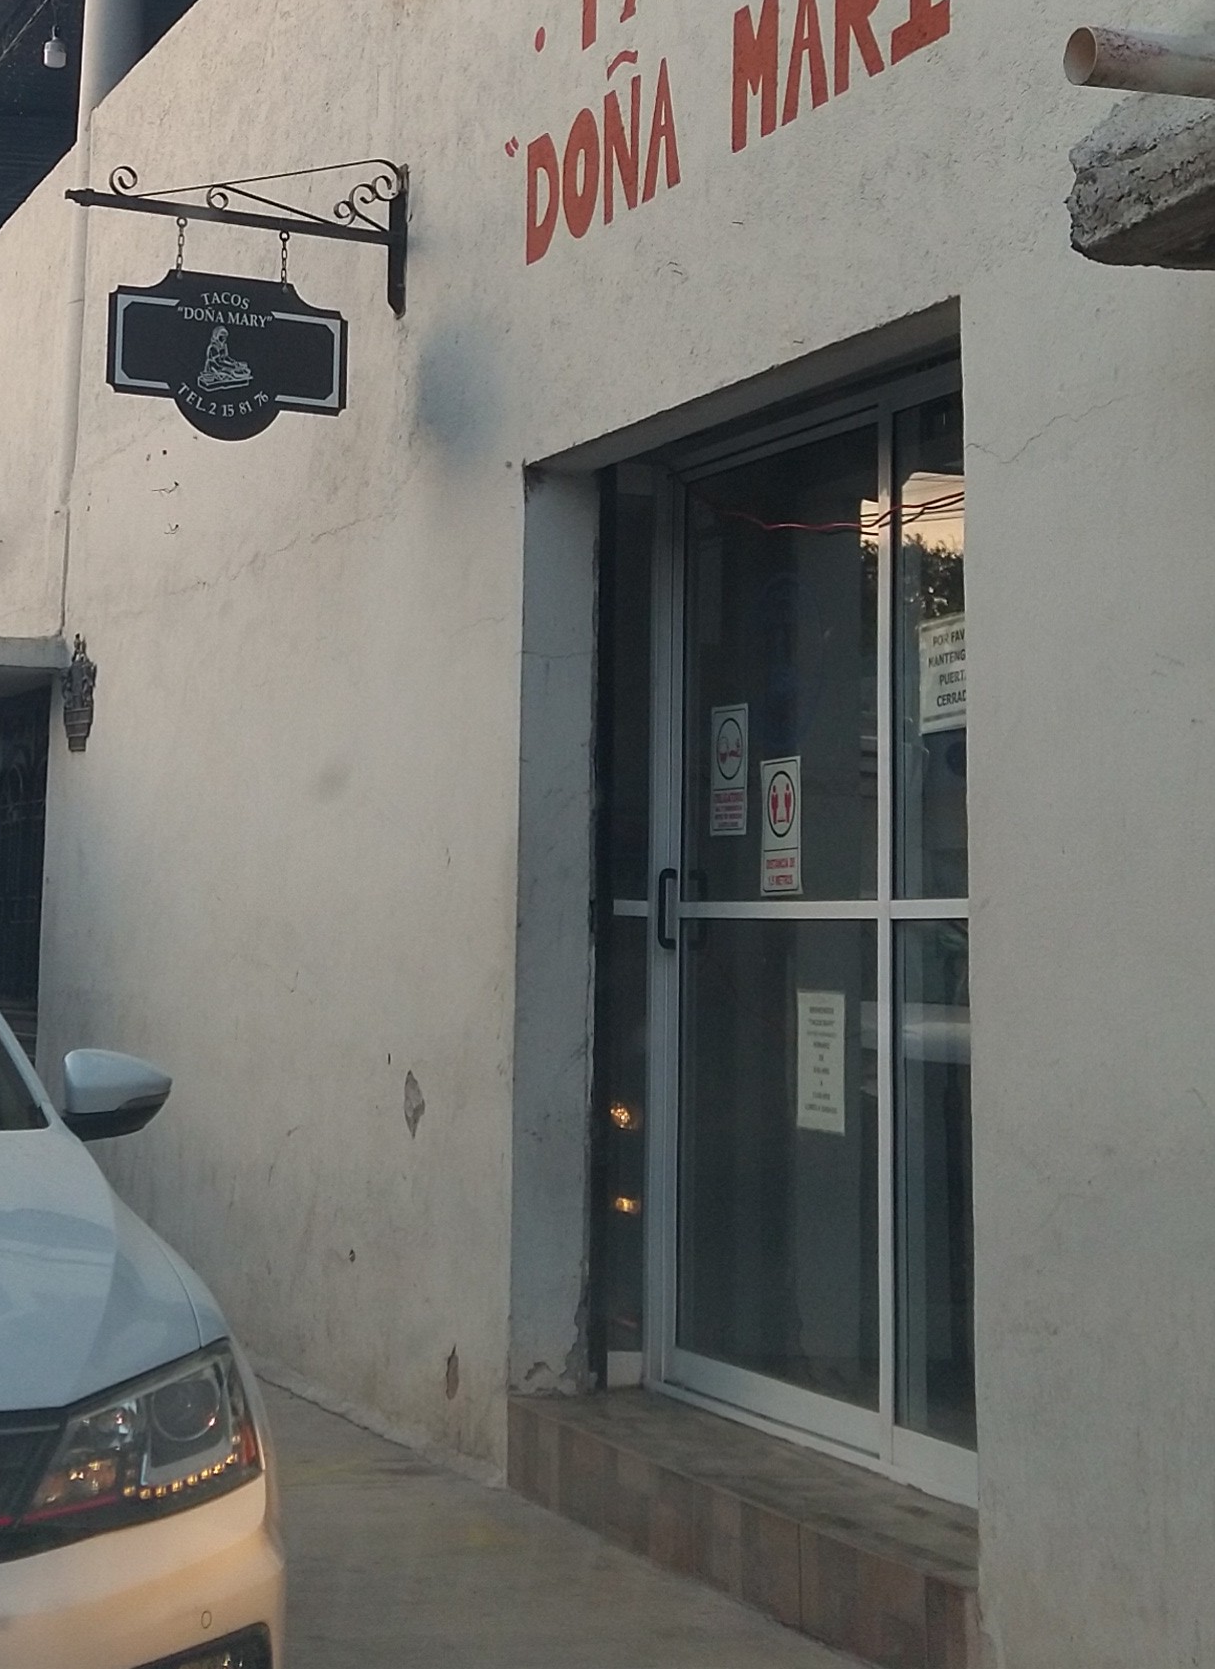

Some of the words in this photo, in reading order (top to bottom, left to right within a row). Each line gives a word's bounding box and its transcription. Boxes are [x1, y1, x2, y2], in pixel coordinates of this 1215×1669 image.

[200, 291, 251, 310] TACOS
[208, 402, 217, 416] 2
[222, 404, 235, 418] 15
[238, 400, 253, 415] 81
[253, 390, 269, 407] 76
[939, 669, 966, 687] PUERT
